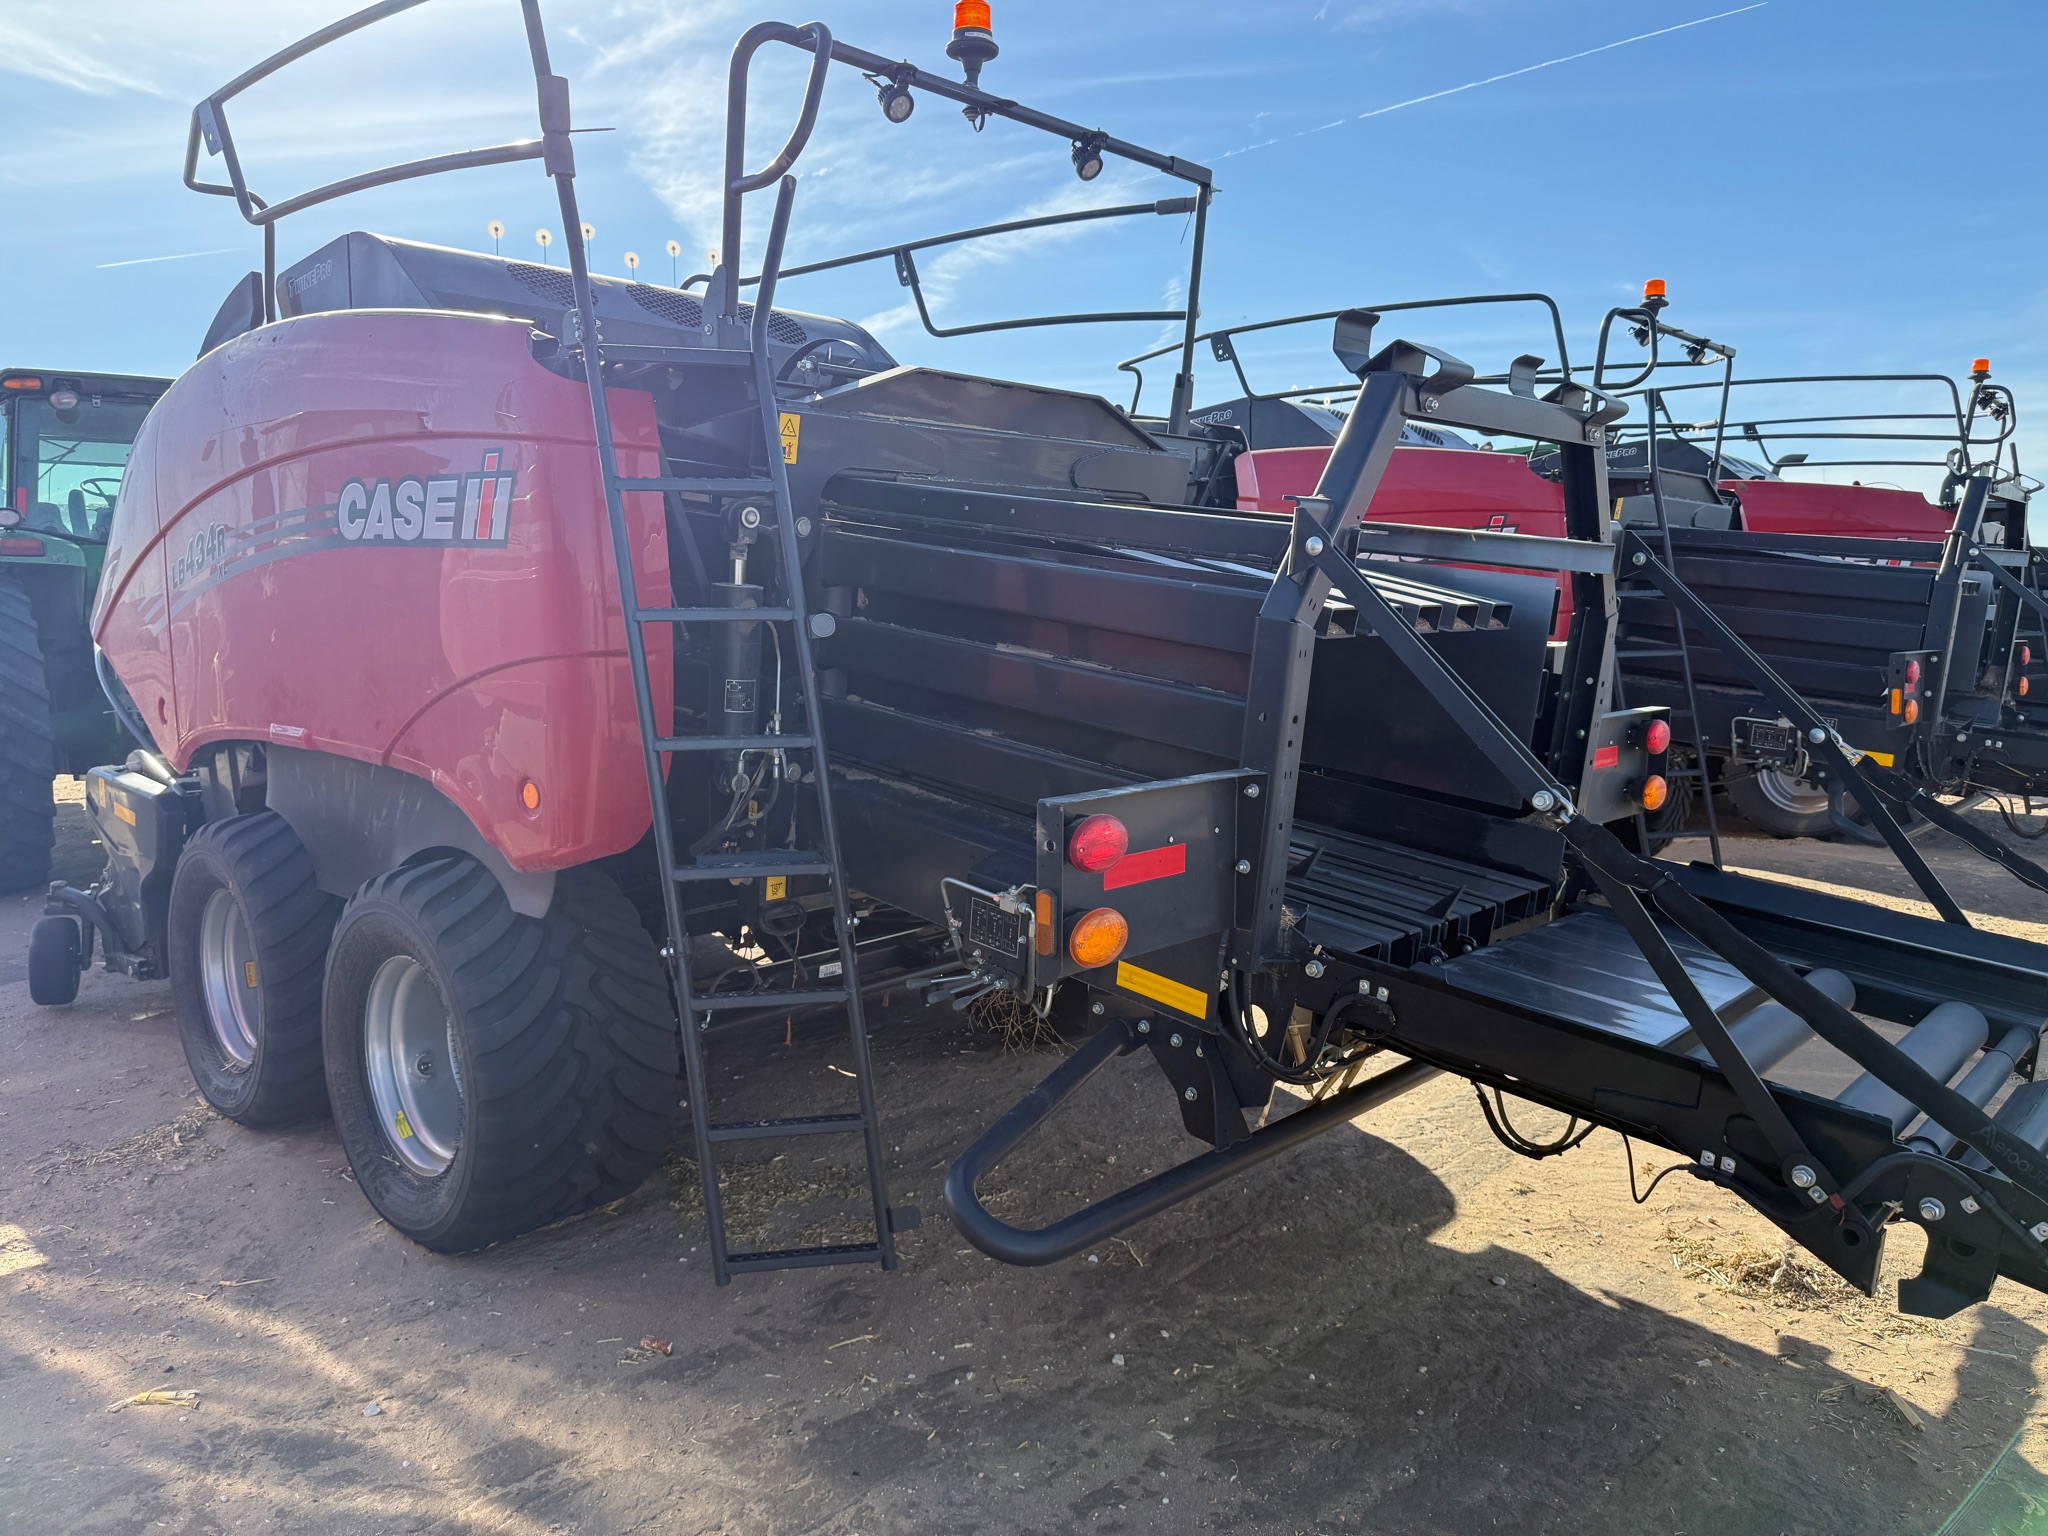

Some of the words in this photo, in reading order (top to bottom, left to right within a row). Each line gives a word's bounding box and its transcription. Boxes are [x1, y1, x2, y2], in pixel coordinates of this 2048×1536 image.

[1605, 447, 1637, 459] NEPRO
[338, 479, 458, 541] CASE
[171, 521, 226, 590] LB434R
